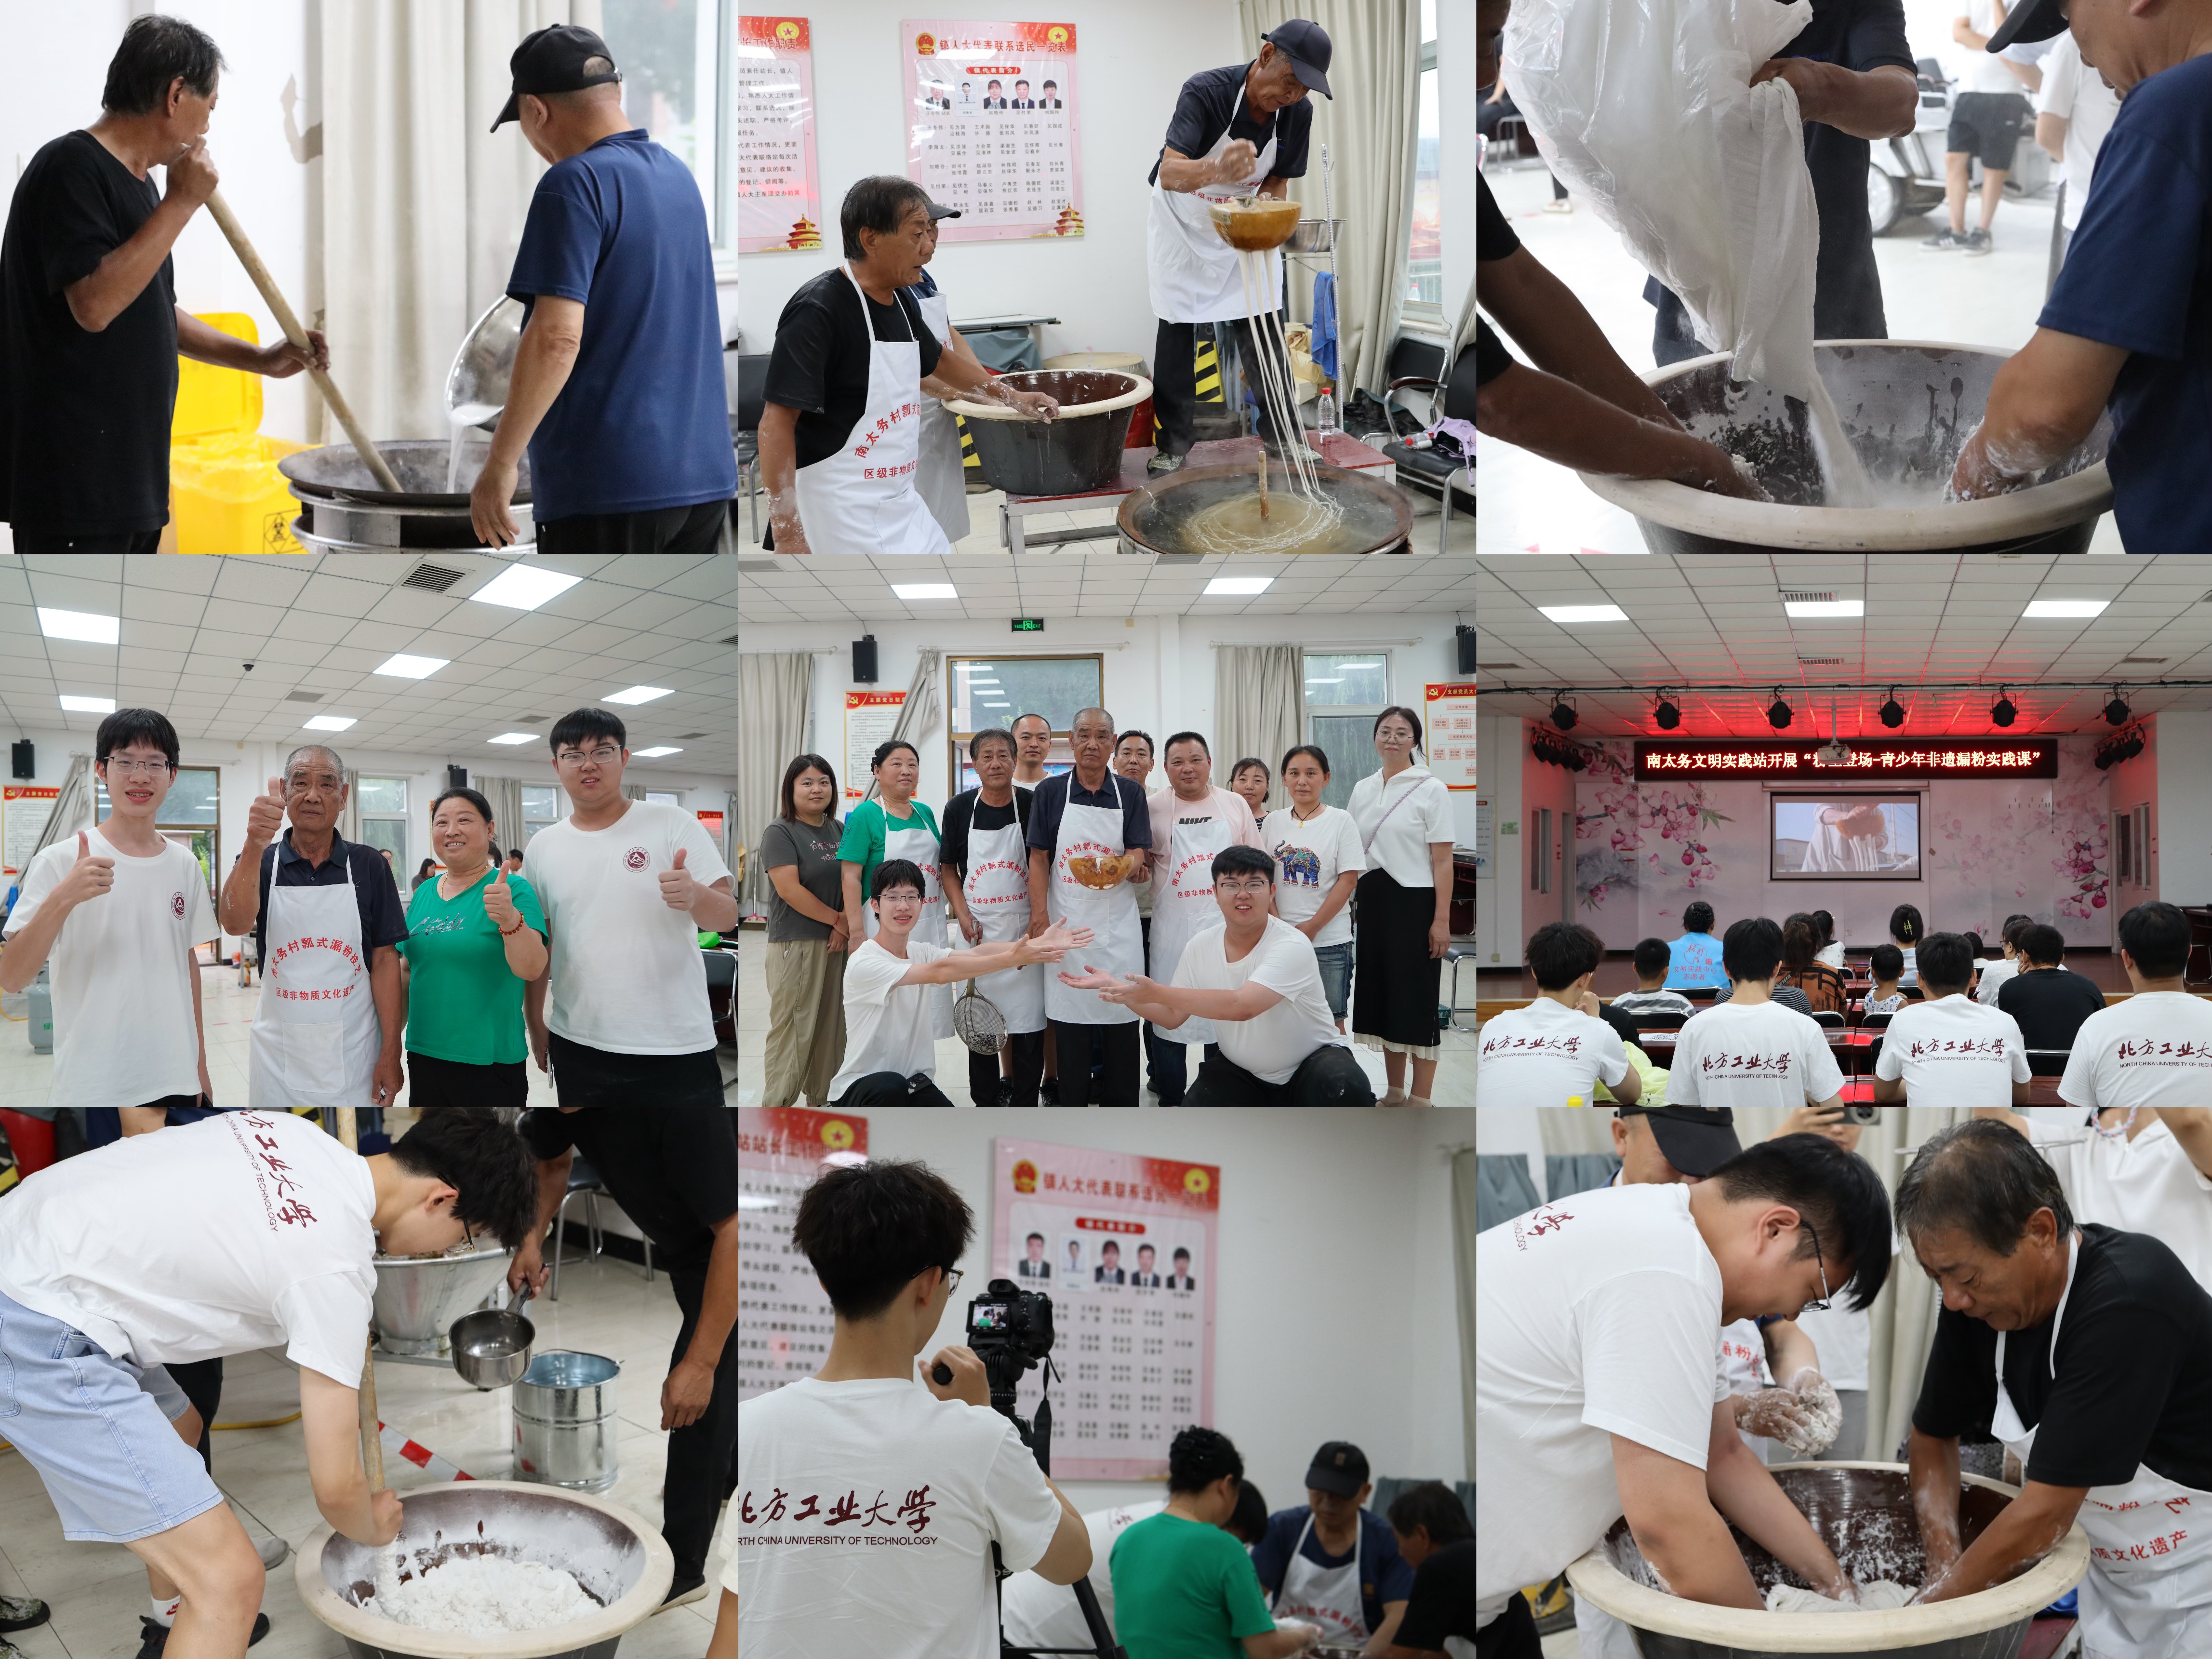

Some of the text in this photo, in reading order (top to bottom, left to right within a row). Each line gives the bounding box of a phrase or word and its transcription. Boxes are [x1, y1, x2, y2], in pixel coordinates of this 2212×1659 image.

[940, 39, 1067, 53] 镇人大代表联系选民一览表
[1172, 853, 1218, 886] 南太务村瓢式
[973, 891, 1027, 904] 区级非物质文化遗产
[1178, 888, 1213, 898] 区级非物质
[271, 937, 361, 978] 南太务村瓢式漏粉技艺
[1674, 965, 1717, 974] 文明实践中心
[276, 985, 355, 1001] 区级非物质文化遗产
[1545, 1052, 1579, 1061] TECHNOLOGY
[228, 1119, 239, 1131] CHINA
[252, 1162, 260, 1171] OF
[256, 1173, 278, 1232] TECHNOLOGY
[758, 1536, 783, 1545] CHINA
[785, 1536, 846, 1545] UNIVERSITY
[848, 1536, 862, 1545] OF
[864, 1536, 938, 1545] TECHNOLOGY
